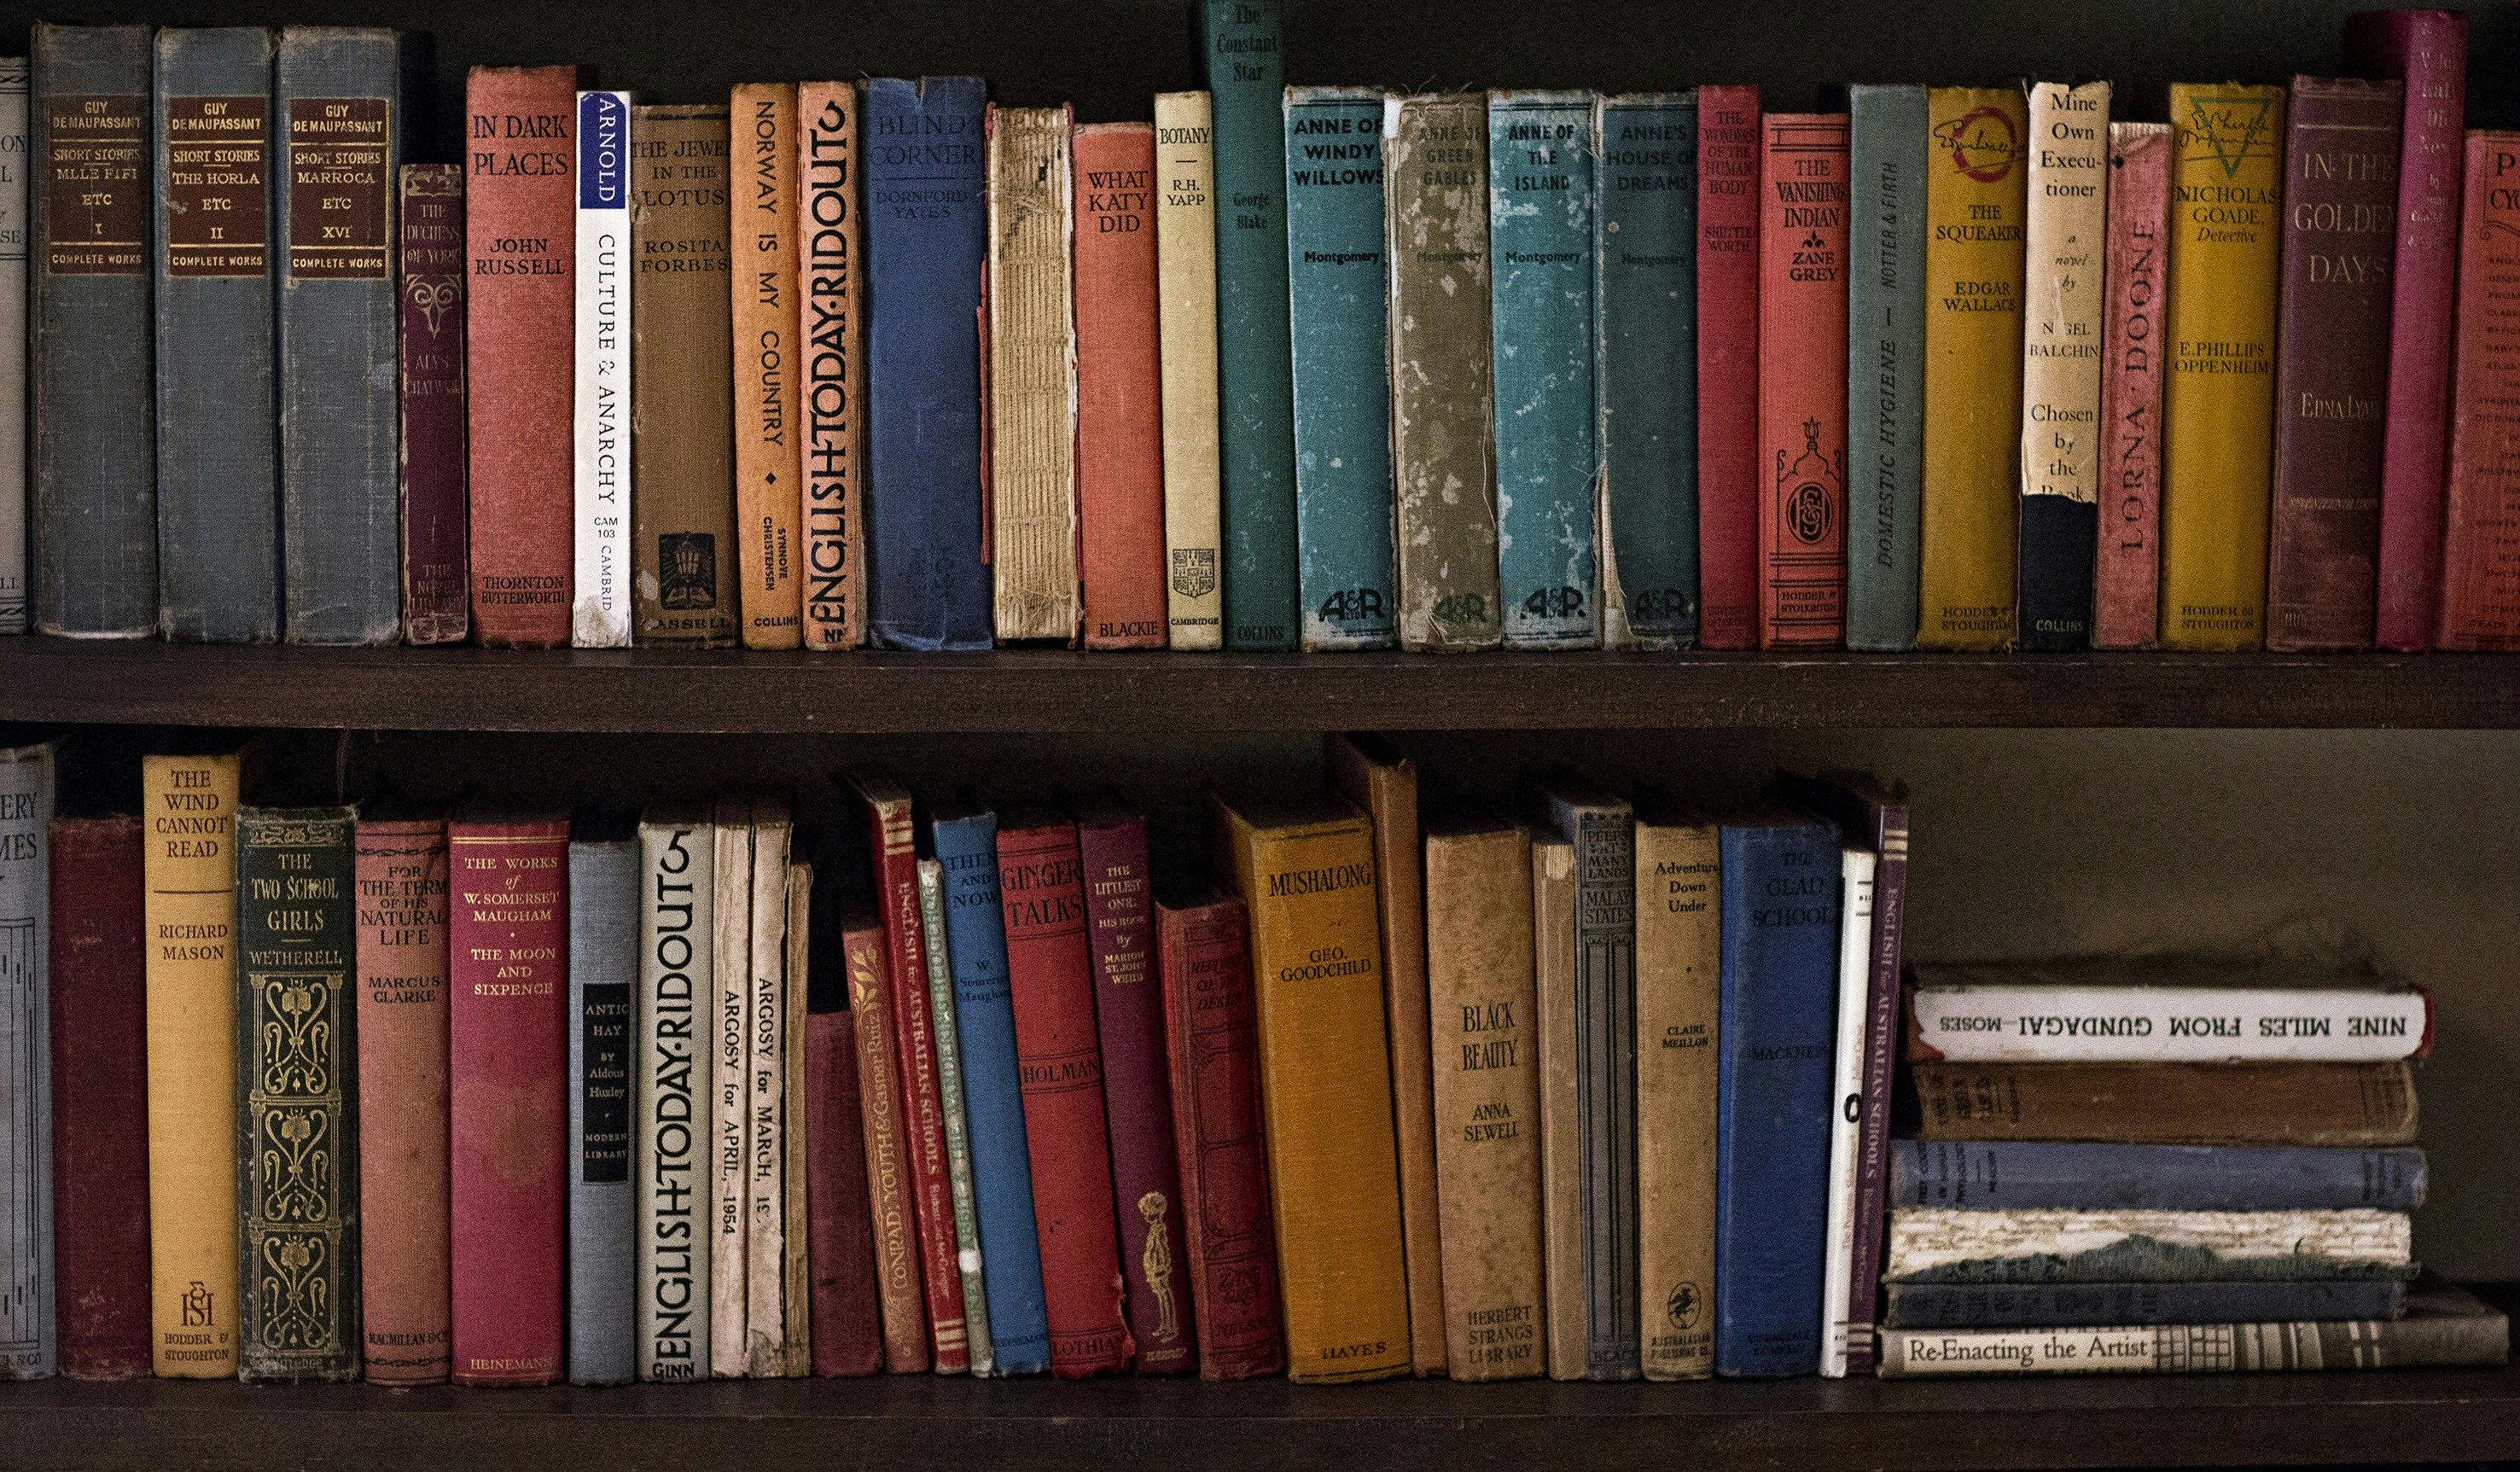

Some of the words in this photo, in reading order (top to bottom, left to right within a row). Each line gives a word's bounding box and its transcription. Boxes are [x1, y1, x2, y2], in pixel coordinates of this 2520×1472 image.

[1217, 34, 1279, 53] Constant
[1233, 62, 1265, 82] Star
[85, 102, 108, 113] GUY
[204, 102, 228, 115] GUY
[2051, 94, 2098, 111] Mine
[325, 105, 348, 118] GUY
[1717, 112, 1744, 125] THE
[293, 121, 308, 132] DE
[310, 121, 381, 133] MAUPASSANT
[473, 116, 496, 139] IN
[505, 115, 567, 138] DARK
[879, 114, 974, 135] BLIND
[2052, 123, 2095, 140] Own
[1160, 128, 1210, 145] BOTANY
[54, 148, 90, 160] SHORT
[94, 148, 140, 160] STORIES
[173, 150, 211, 162] SHORT
[214, 150, 259, 162] STORIES
[598, 97, 616, 202] ARNOLD
[869, 144, 975, 166] CORNER
[1304, 144, 1376, 160] WINDY
[1426, 149, 1475, 164] GREEN
[294, 153, 333, 164] SHORT
[335, 152, 381, 164] STORIES
[473, 153, 568, 177] PLACES
[755, 101, 778, 215] NORWAY
[1607, 151, 1670, 166] HOUSE
[2041, 150, 2102, 169] Execu-
[57, 169, 100, 179] MLLE
[104, 169, 137, 179] FIFI
[1795, 160, 1830, 176] THE
[173, 172, 203, 184] THE
[207, 172, 259, 184] HORLA
[298, 172, 375, 183] MARROCA
[1088, 171, 1149, 189] WHAT
[1294, 170, 1384, 186] WILLOWS
[1515, 176, 1570, 191] ISLAND
[1617, 177, 1688, 192] DREAMS
[1709, 180, 1748, 195] BODY
[2046, 180, 2097, 198] tioner
[2177, 187, 2278, 204] NICHOLAS
[82, 194, 112, 205] ETC
[202, 198, 231, 210] ETC
[322, 198, 352, 210] ETC
[643, 189, 724, 207] LOTUS
[1089, 194, 1149, 212] KATY
[1166, 194, 1206, 207] YAPP
[1784, 209, 1840, 229] INDIAN
[1970, 205, 2002, 220] THE
[1099, 215, 1142, 234] DID
[322, 227, 351, 239] XVI
[1936, 224, 2023, 245] SQUEAKER
[2196, 227, 2258, 242] Detective
[490, 238, 548, 253] JOHN
[645, 240, 721, 253] ROSITA
[758, 234, 778, 253] IS
[52, 254, 103, 265] COMPLETE
[108, 254, 142, 265] WORKS
[172, 256, 224, 266] COMPLETE
[227, 256, 263, 266] WORKS
[292, 259, 344, 269] COMPLETE
[348, 259, 382, 269] WORKS
[641, 259, 728, 272] FORBES
[1303, 251, 1380, 265] Montgomery
[1504, 251, 1581, 265] Montgomery
[1792, 253, 1835, 265] ZANE
[474, 259, 566, 276] RUSSELL
[1790, 269, 1837, 282] GREY
[598, 233, 615, 350] CULTURE
[759, 271, 779, 309] MY
[1955, 282, 2011, 295] EDGAR
[2124, 220, 2155, 374] DOONE
[2029, 345, 2099, 357] BALCHIN
[599, 361, 614, 375] &
[2174, 360, 2271, 375] OPPENHEIM
[760, 330, 784, 447] COUNTRY
[2030, 404, 2094, 422] Chosen
[598, 387, 615, 503] ANARCHY
[2121, 406, 2145, 550] LORNA
[482, 575, 565, 591] THORNTON
[754, 617, 800, 628] COLLINS
[1100, 621, 1158, 637] BLACKIE
[171, 770, 211, 788] THE
[163, 793, 219, 811] WIND
[156, 816, 228, 835] CANNOT
[166, 840, 218, 858] READ
[278, 853, 311, 870] THE
[464, 857, 497, 870] THE
[506, 857, 557, 870] WORKS
[1586, 856, 1628, 867] MANY
[388, 865, 421, 878] FOR
[1001, 858, 1081, 892] GINGER
[1106, 864, 1132, 878] THE
[1587, 869, 1628, 880] LANDS
[252, 878, 281, 899] TWO
[287, 876, 339, 899] SCHOOL
[1095, 879, 1143, 896] LITTLEST
[1269, 862, 1371, 898] MUSHALONG
[1669, 881, 1707, 894] Down
[1007, 896, 1084, 928] TALKS
[1668, 900, 1707, 914] Under
[267, 910, 324, 932] GIRLS
[360, 911, 445, 927] NATURAL
[474, 910, 552, 922] MAUGHAM
[1753, 905, 1835, 928] SCHOOL
[159, 923, 229, 939] RICHARD
[379, 931, 430, 945] LIFE
[163, 945, 225, 960] MASON
[249, 951, 342, 965] WETHERELL
[471, 948, 503, 961] THE
[509, 948, 556, 961] MOON
[497, 966, 533, 979] AND
[1280, 957, 1372, 982] GOODCHILD
[369, 976, 440, 990] MARCUS
[474, 983, 554, 997] SIXPENCE
[373, 991, 437, 1004] CLARKE
[585, 1003, 630, 1015] ANTIC
[758, 977, 774, 1057] ARGOSY
[1462, 1002, 1516, 1033] BLACK
[1940, 1015, 2001, 1033] MOSES
[2019, 1015, 2152, 1036] GUNDAGAI
[2170, 1015, 2241, 1036] FROM
[2259, 1015, 2331, 1036] MILES
[2348, 1015, 2407, 1035] NINE
[593, 1025, 622, 1037] HAY
[725, 991, 740, 1070] ARGOSY
[1667, 1026, 1706, 1037] CLAIRE
[1462, 1039, 1517, 1072] BEAUTY
[1024, 1058, 1102, 1083] HOLMAN
[757, 1069, 772, 1094] for
[725, 1084, 739, 1108] for
[1471, 1103, 1511, 1121] ANNA
[1464, 1122, 1519, 1142] SEWELL
[722, 1120, 741, 1182] APRIL,
[755, 1107, 773, 1183] MARCH,
[723, 1196, 737, 1235] 1954
[1467, 1306, 1533, 1324] HERBERT
[1322, 1341, 1387, 1361] HAYES
[1468, 1343, 1532, 1364] LIBRARY
[1909, 1337, 2032, 1368] Re-Enacting
[2044, 1338, 2077, 1359] the
[2086, 1336, 2148, 1359] Artist
[470, 1357, 554, 1370] HEINEMANN
[652, 1362, 695, 1378] GINN
